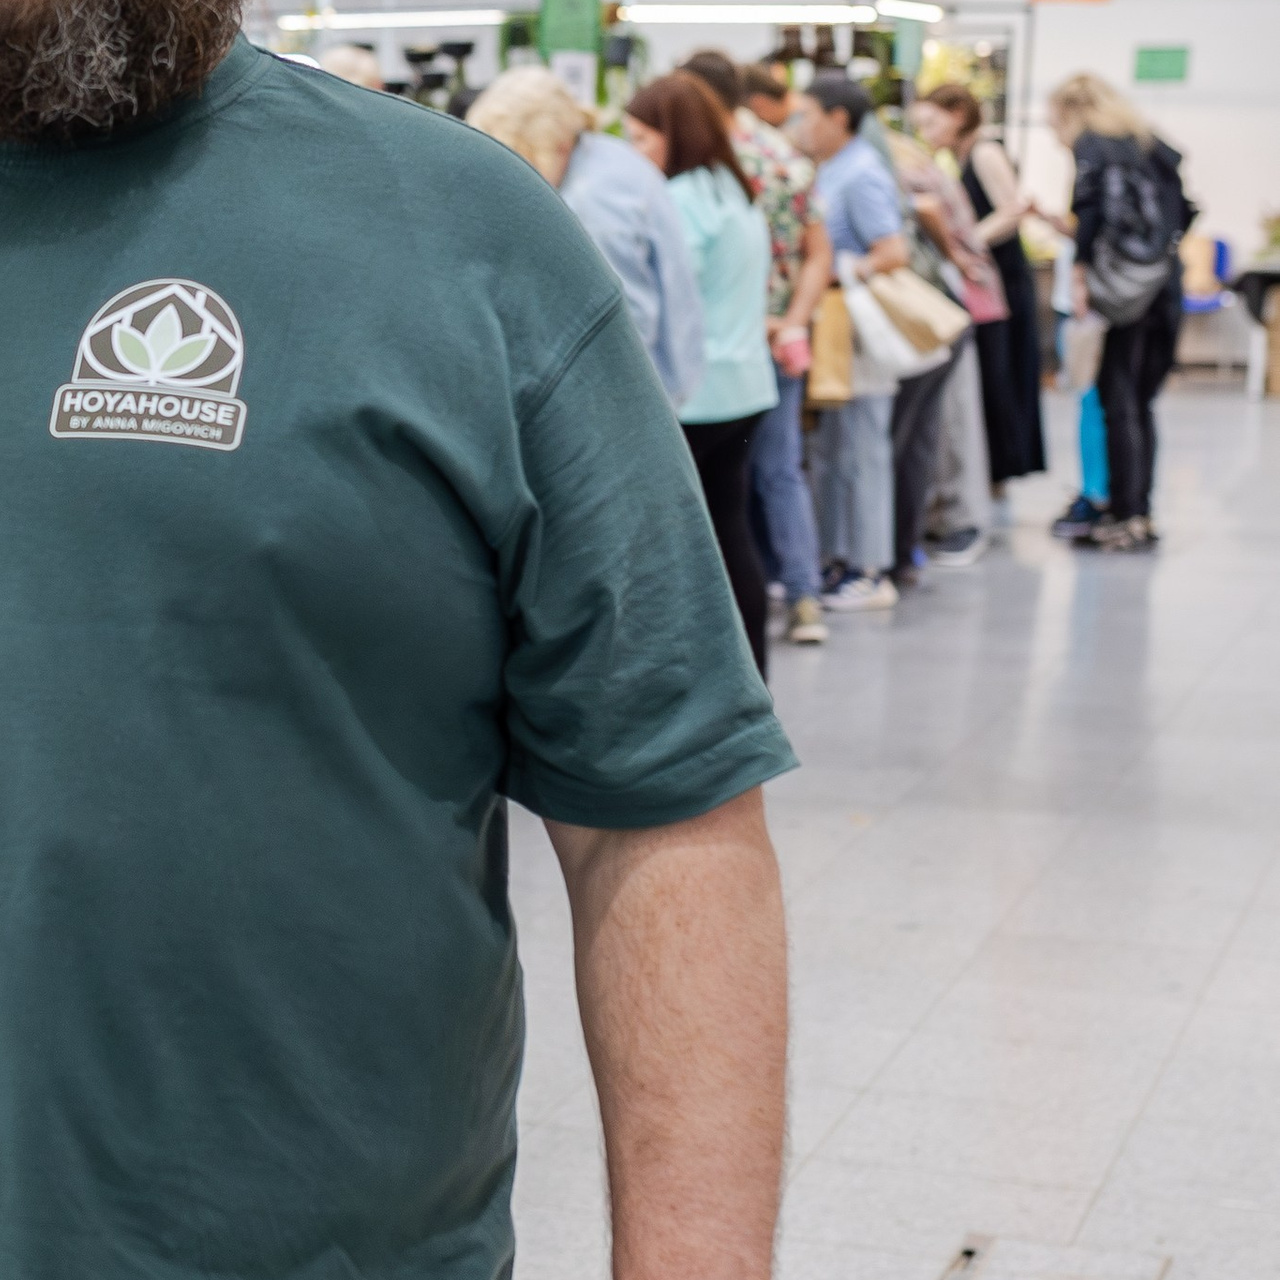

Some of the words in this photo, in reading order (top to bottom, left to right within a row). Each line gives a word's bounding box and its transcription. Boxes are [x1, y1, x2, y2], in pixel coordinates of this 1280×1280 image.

[62, 390, 236, 427] HOYAHOUSE
[69, 415, 88, 430] BY
[92, 416, 138, 431] ANNA
[141, 418, 224, 440] MIGOVICH
